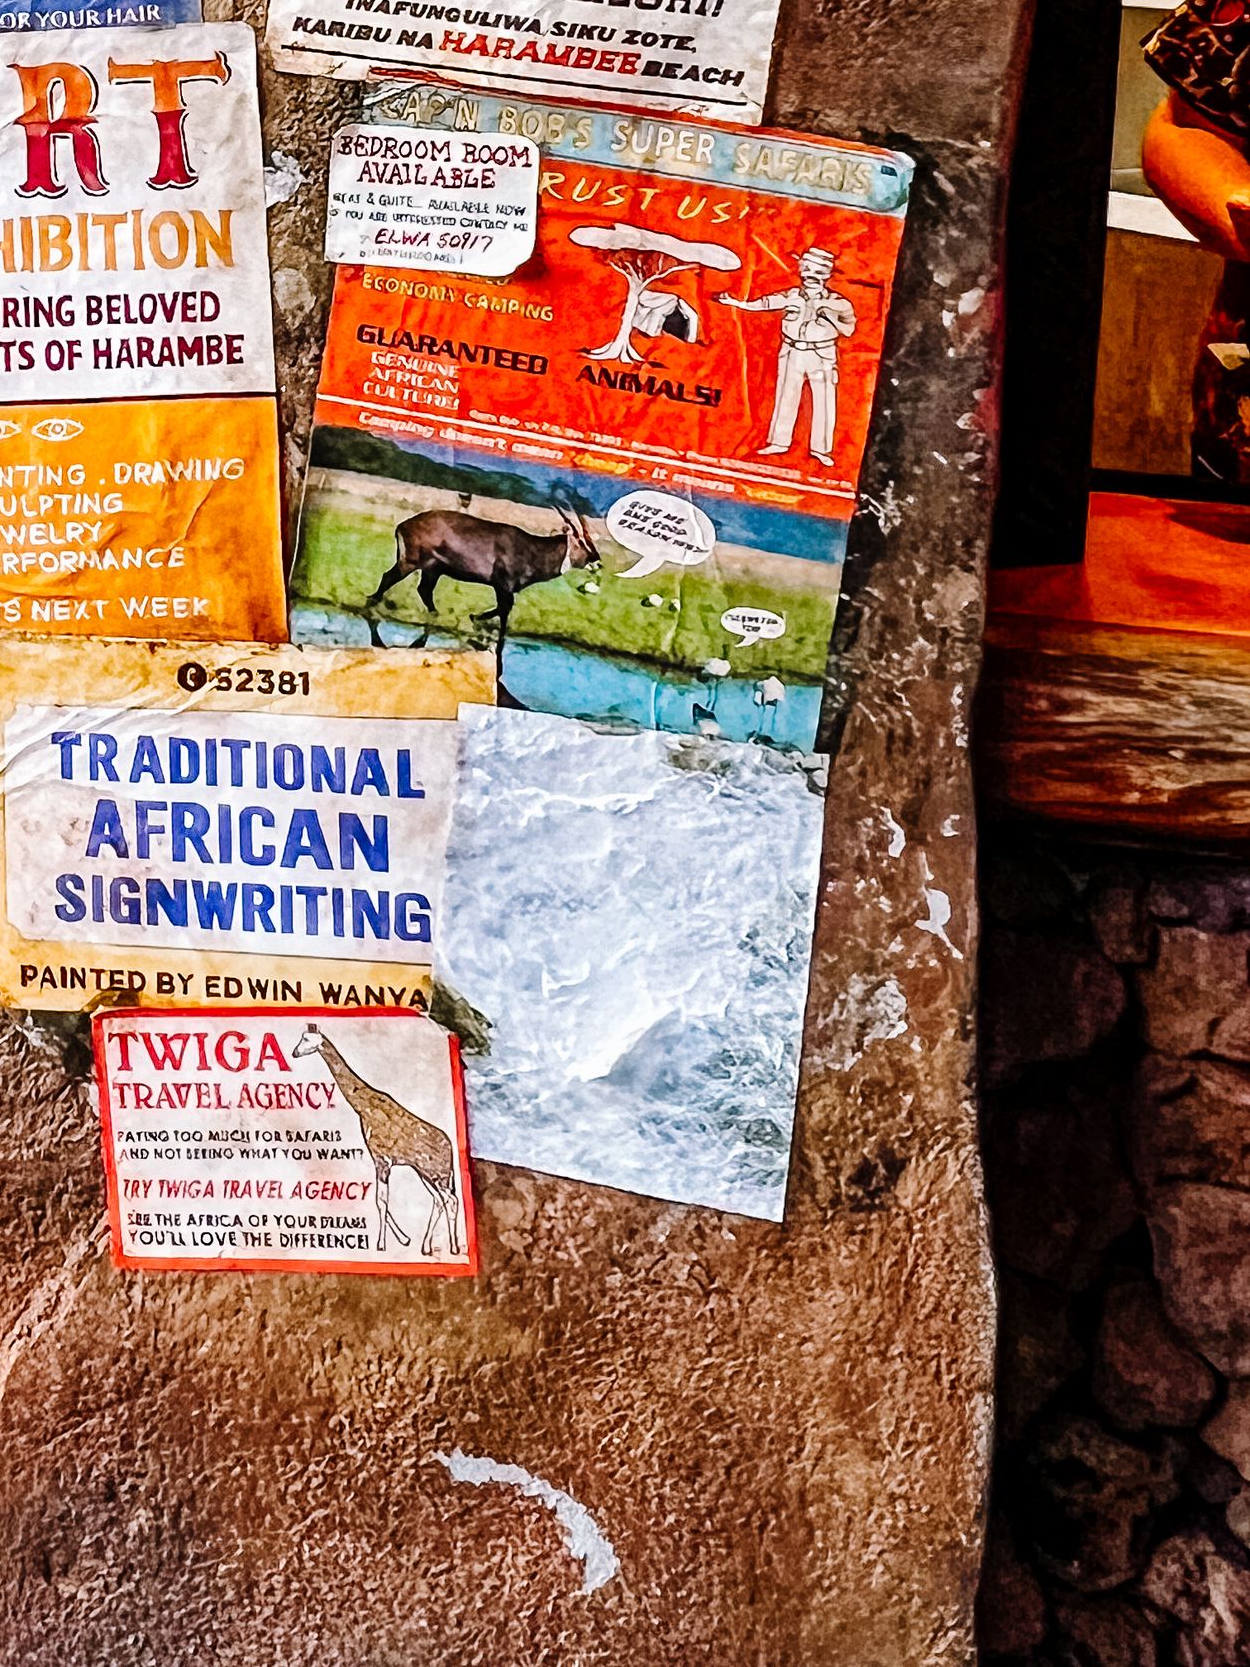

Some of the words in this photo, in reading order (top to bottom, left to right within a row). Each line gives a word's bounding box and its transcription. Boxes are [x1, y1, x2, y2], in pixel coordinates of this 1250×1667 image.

[35, 9, 101, 30] YOUR
[107, 4, 162, 24] HAIR
[550, 20, 617, 43] SIKU
[291, 16, 393, 44] KARIBU
[400, 32, 434, 50] NA
[438, 30, 640, 76] HARAMBEE
[640, 60, 746, 88] BEACH
[337, 134, 451, 162] BEDROOM
[610, 120, 715, 165] SUPER
[733, 142, 872, 194] SAFARIS
[356, 161, 496, 189] AVAILABLE
[86, 290, 220, 326] BELOVED
[464, 292, 554, 322] CAMPING
[44, 339, 83, 372] OF
[93, 334, 245, 371] HARAMBE
[357, 324, 549, 376] GUARANTEED
[574, 364, 723, 408] ANIMALS!
[369, 367, 460, 394] AFRICAN
[113, 457, 245, 486] DRAWING
[30, 597, 109, 622] NEXT
[119, 596, 211, 621] WEEK
[215, 666, 311, 696] 52381
[50, 731, 426, 800] TRADITIONAL
[85, 799, 390, 874] AFRICAN
[54, 873, 432, 944] SIGNWRITING
[20, 965, 146, 993] PAINTED
[156, 973, 195, 996] BY
[205, 975, 303, 1003] EDWIN
[319, 981, 428, 1011] WANYA
[108, 1030, 292, 1073] TWIGA
[112, 1082, 232, 1110] TRAVEL
[237, 1081, 337, 1110] AGENCY
[173, 1131, 202, 1142] TOO
[254, 1131, 282, 1142] FOR
[118, 1149, 149, 1161] AND
[154, 1149, 181, 1160] NOT
[240, 1149, 278, 1160] WHAT
[282, 1149, 312, 1160] YOU
[123, 1179, 152, 1200] TRY
[158, 1180, 215, 1199] TWIGA
[223, 1180, 284, 1199] TRAVEL
[291, 1182, 373, 1200] AGENCY
[155, 1214, 181, 1226] THE
[187, 1214, 243, 1228] AFRICA
[249, 1215, 268, 1228] OF
[274, 1215, 317, 1229] YOUR
[192, 1231, 236, 1247] LOVE
[243, 1232, 272, 1247] THE
